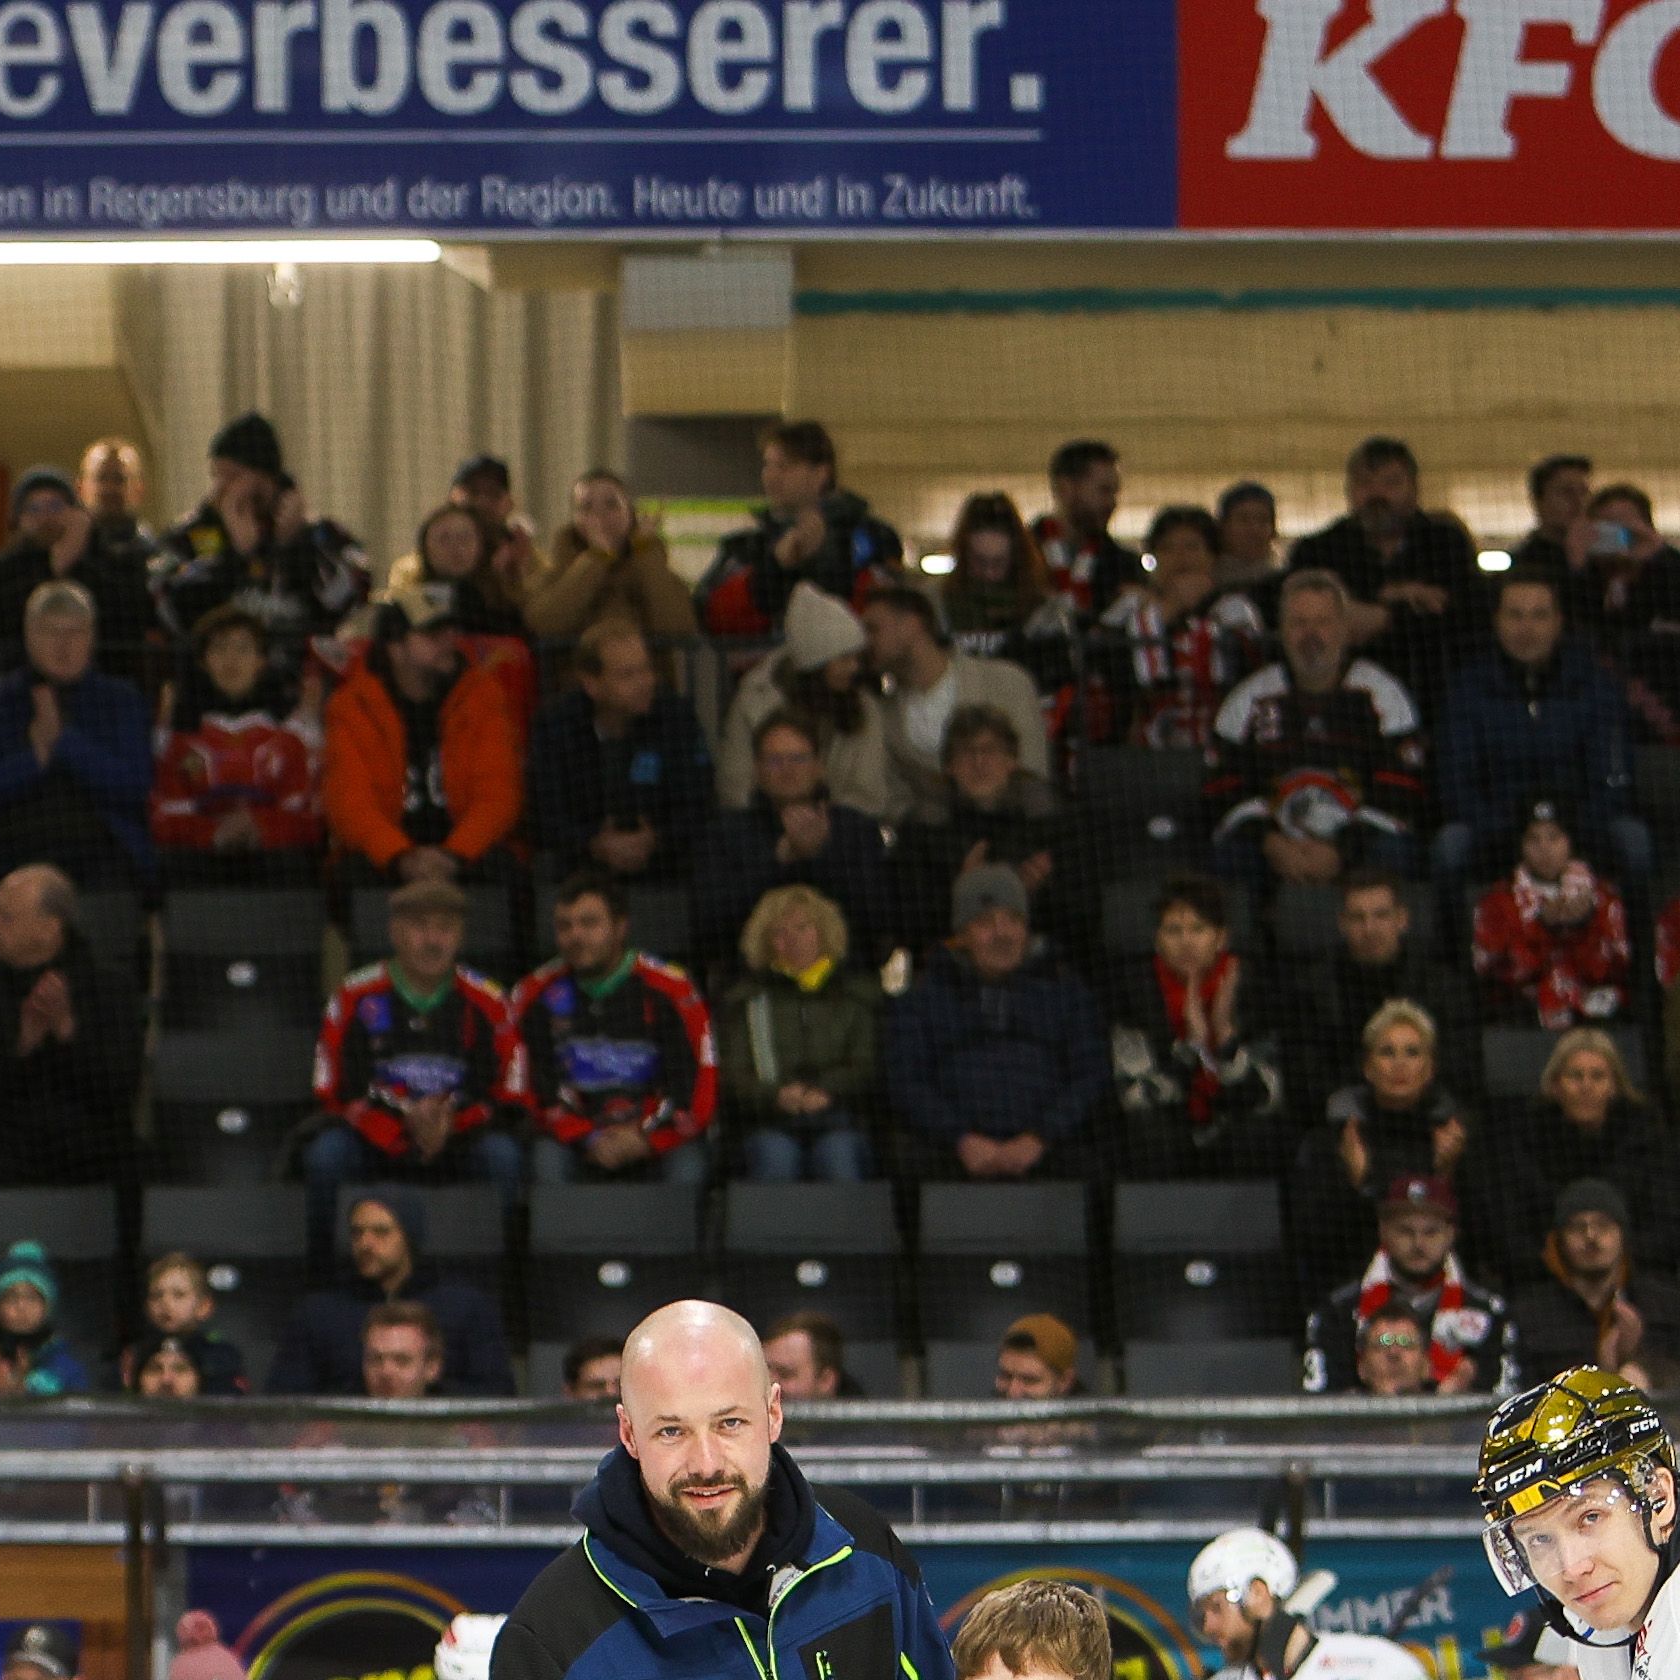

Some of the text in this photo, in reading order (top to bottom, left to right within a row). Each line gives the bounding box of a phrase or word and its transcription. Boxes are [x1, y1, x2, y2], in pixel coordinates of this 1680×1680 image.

[42, 178, 78, 221] in
[87, 176, 316, 229] Regensburg
[325, 176, 395, 220] und
[407, 176, 471, 219] der
[480, 174, 618, 226] Region.
[632, 175, 743, 219] Heute
[753, 175, 826, 218] und
[836, 174, 872, 217] in
[882, 173, 1036, 220] Zukunft.
[1628, 1417, 1660, 1435] CCM
[1493, 1458, 1545, 1494] CCM
